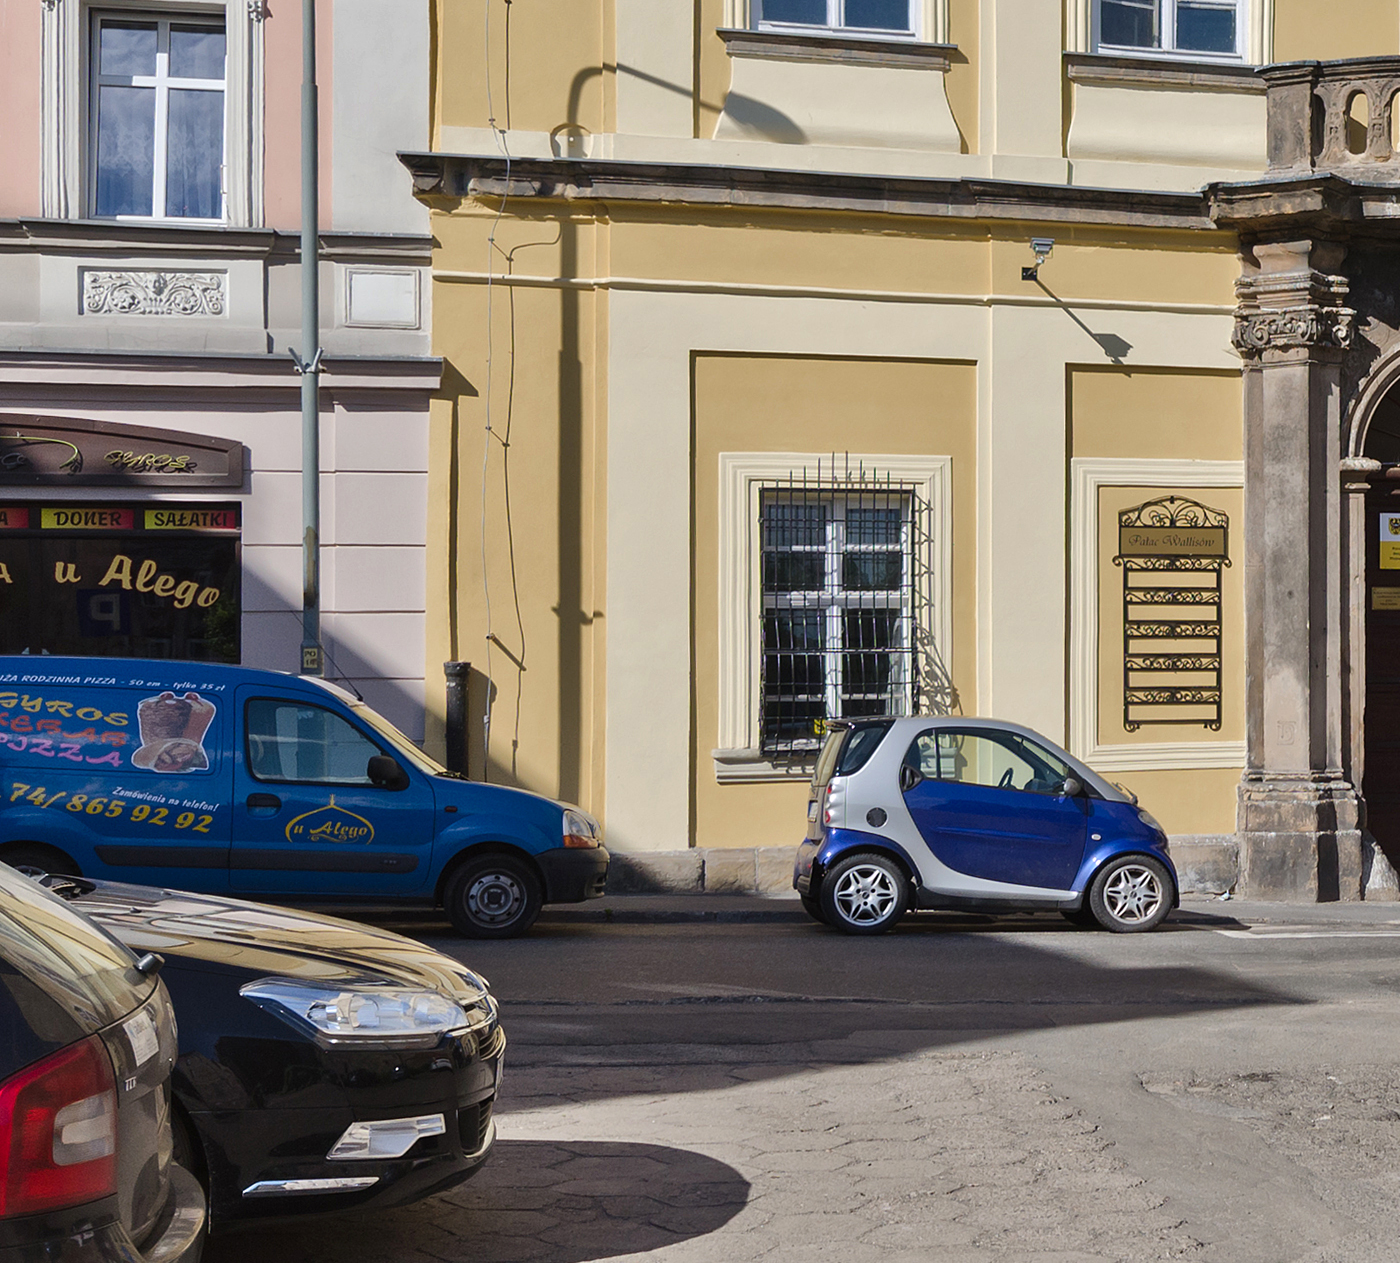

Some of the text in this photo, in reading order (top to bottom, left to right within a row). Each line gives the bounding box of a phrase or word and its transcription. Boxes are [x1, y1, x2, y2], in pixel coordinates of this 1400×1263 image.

[104, 450, 190, 468] GYROS
[54, 512, 121, 526] DONER
[154, 512, 227, 527] SAŁATKI
[55, 561, 81, 583] u
[98, 554, 220, 608] Alego
[21, 675, 80, 684] RODZINNA
[83, 677, 116, 685] PIZZA
[0, 692, 129, 726] GYROS
[112, 786, 166, 804] Zamówienia
[66, 794, 126, 818] 865
[130, 804, 169, 826] 92
[174, 811, 213, 833] 92
[310, 821, 367, 839] Alego
